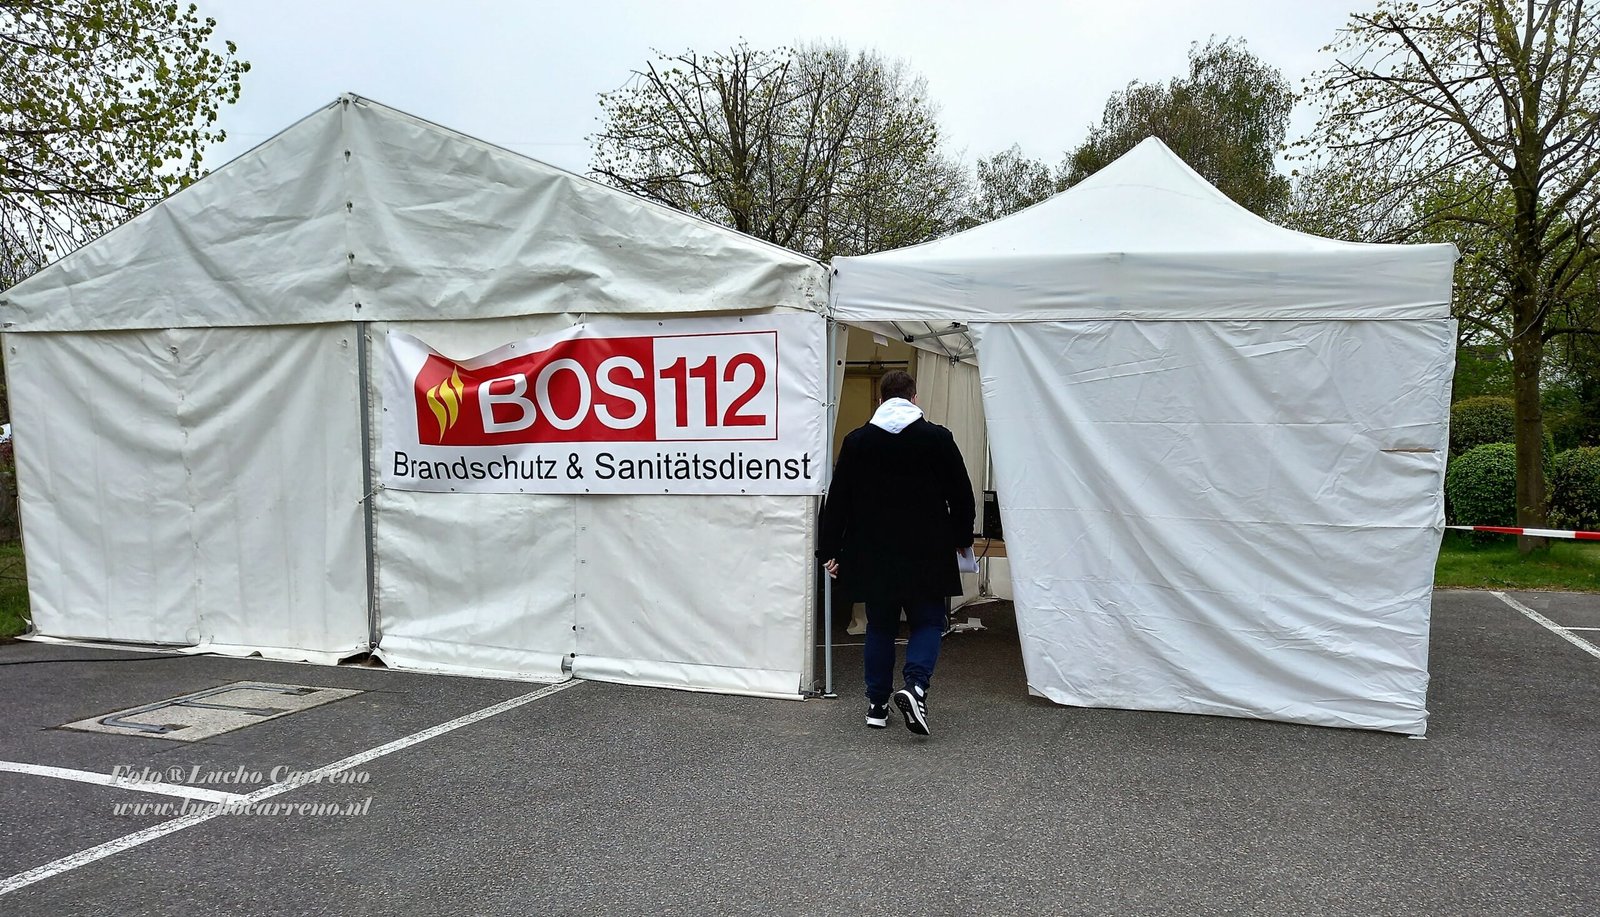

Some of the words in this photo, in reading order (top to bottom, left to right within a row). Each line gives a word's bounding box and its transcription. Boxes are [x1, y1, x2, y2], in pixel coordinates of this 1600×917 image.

[393, 450, 557, 480] Brandschutz
[566, 454, 585, 480] &
[594, 451, 812, 481] Sanitätsdienst
